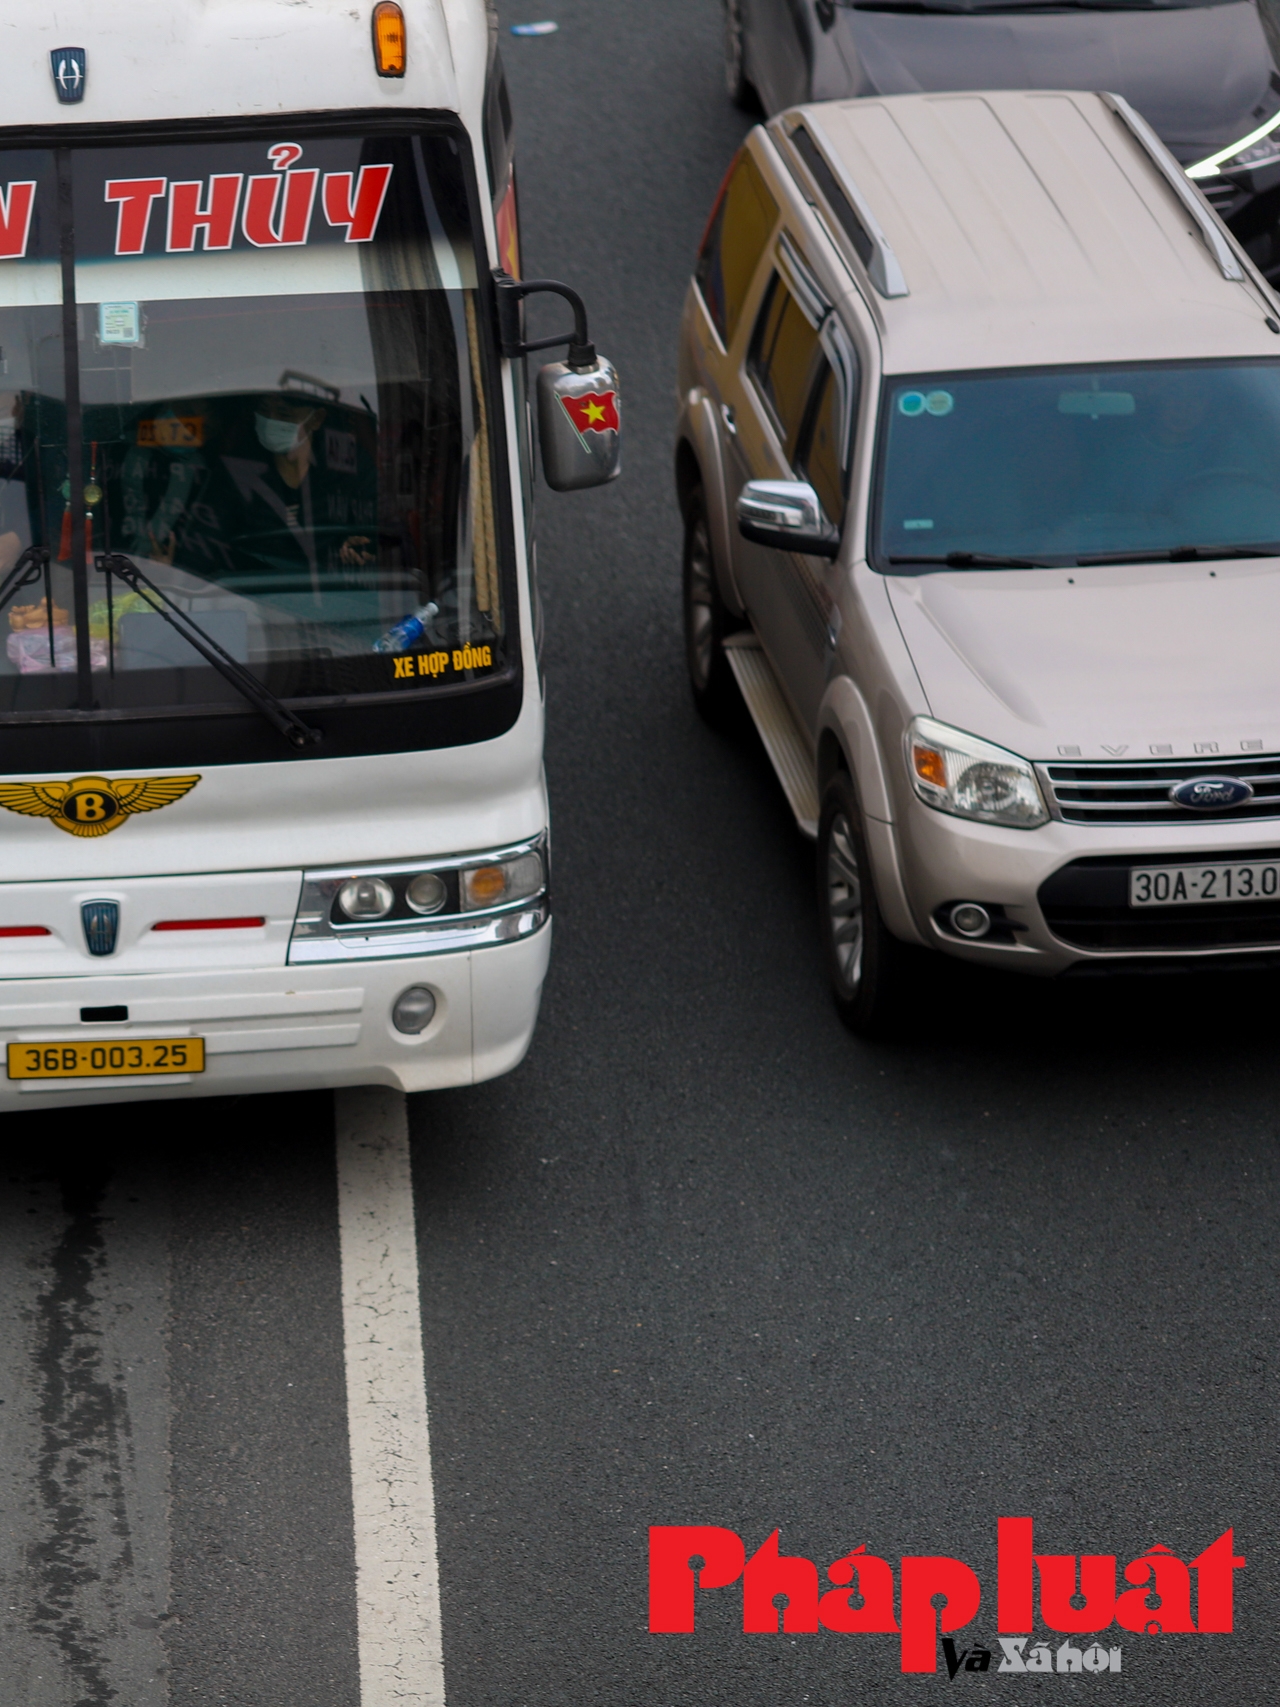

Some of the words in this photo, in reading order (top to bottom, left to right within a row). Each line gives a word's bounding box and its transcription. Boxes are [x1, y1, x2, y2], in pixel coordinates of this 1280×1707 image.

[104, 142, 394, 255] THỦY
[393, 656, 415, 679] XE
[417, 651, 450, 678] HỢP
[452, 641, 492, 671] ĐỒNG
[1057, 739, 1264, 757] EVERE
[1190, 781, 1235, 804] Ford
[75, 793, 106, 822] B
[1135, 867, 1280, 903] 30A-213.0
[25, 1044, 188, 1072] 36B-003.25
